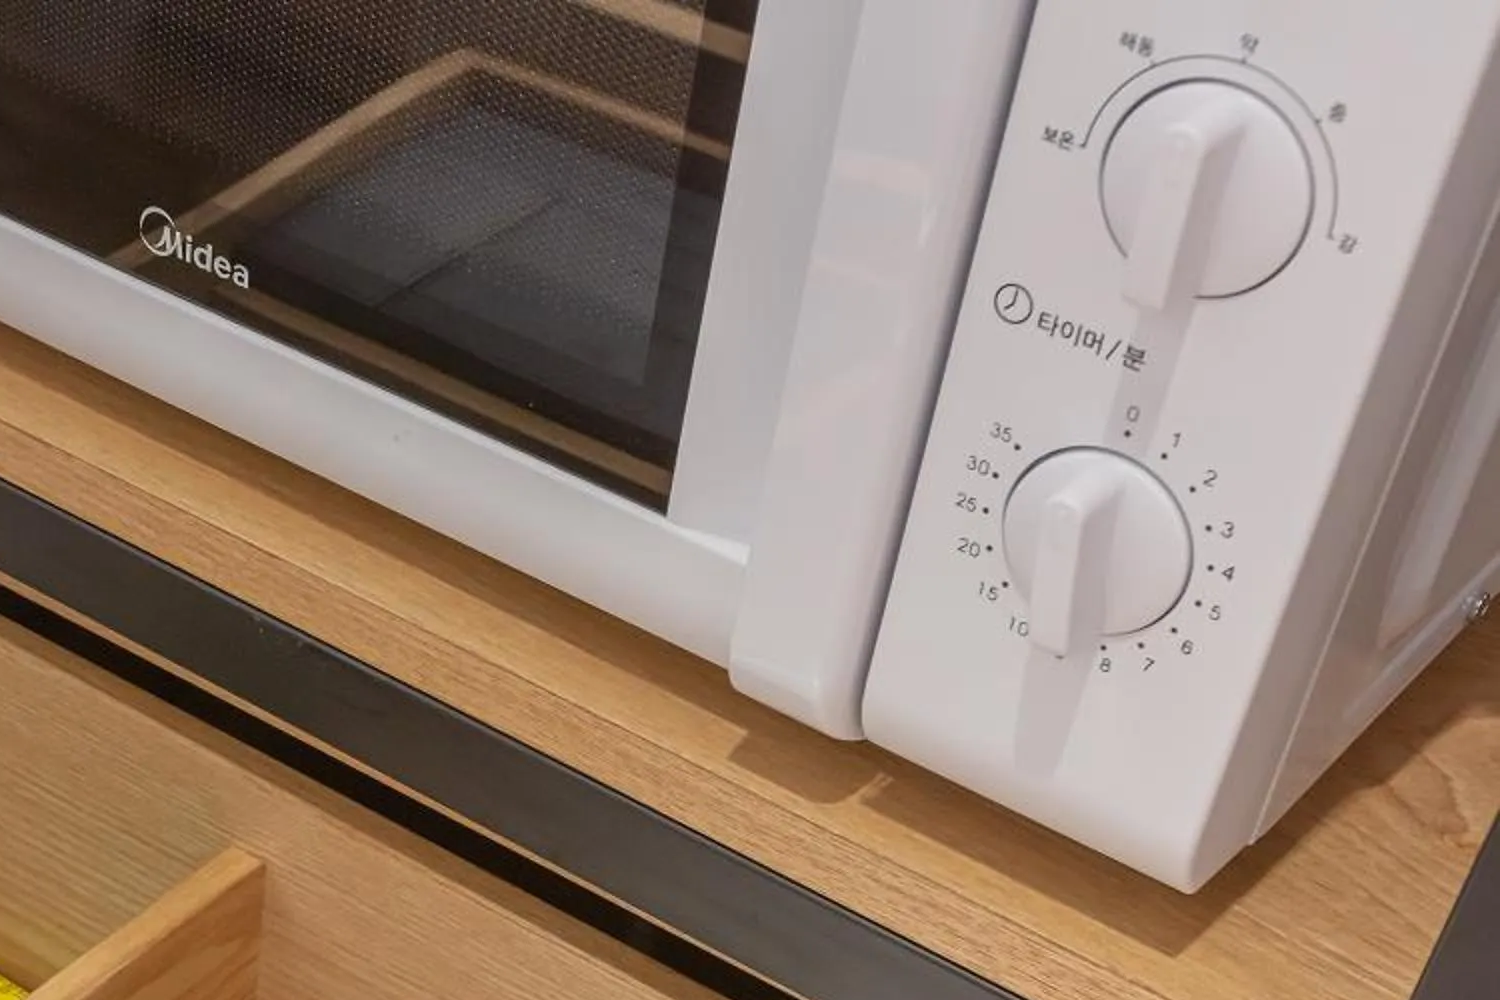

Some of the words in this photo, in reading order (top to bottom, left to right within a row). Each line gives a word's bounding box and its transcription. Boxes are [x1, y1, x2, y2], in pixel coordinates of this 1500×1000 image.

[1041, 125, 1076, 151] 보온
[139, 205, 249, 289] Midea
[1126, 405, 1140, 422] 0
[989, 422, 1012, 443] 35
[1172, 432, 1182, 448] 1
[966, 455, 990, 476] 30
[1203, 469, 1218, 487] 2
[955, 492, 977, 513] 25
[1220, 521, 1235, 538] 3
[957, 537, 981, 558] 20
[1221, 565, 1235, 581] 4
[978, 581, 999, 602] 15
[1208, 605, 1222, 621] 5
[1007, 616, 1030, 637] 10
[1180, 639, 1194, 655] 6
[1100, 658, 1111, 673] 8
[1143, 658, 1156, 672] 7
